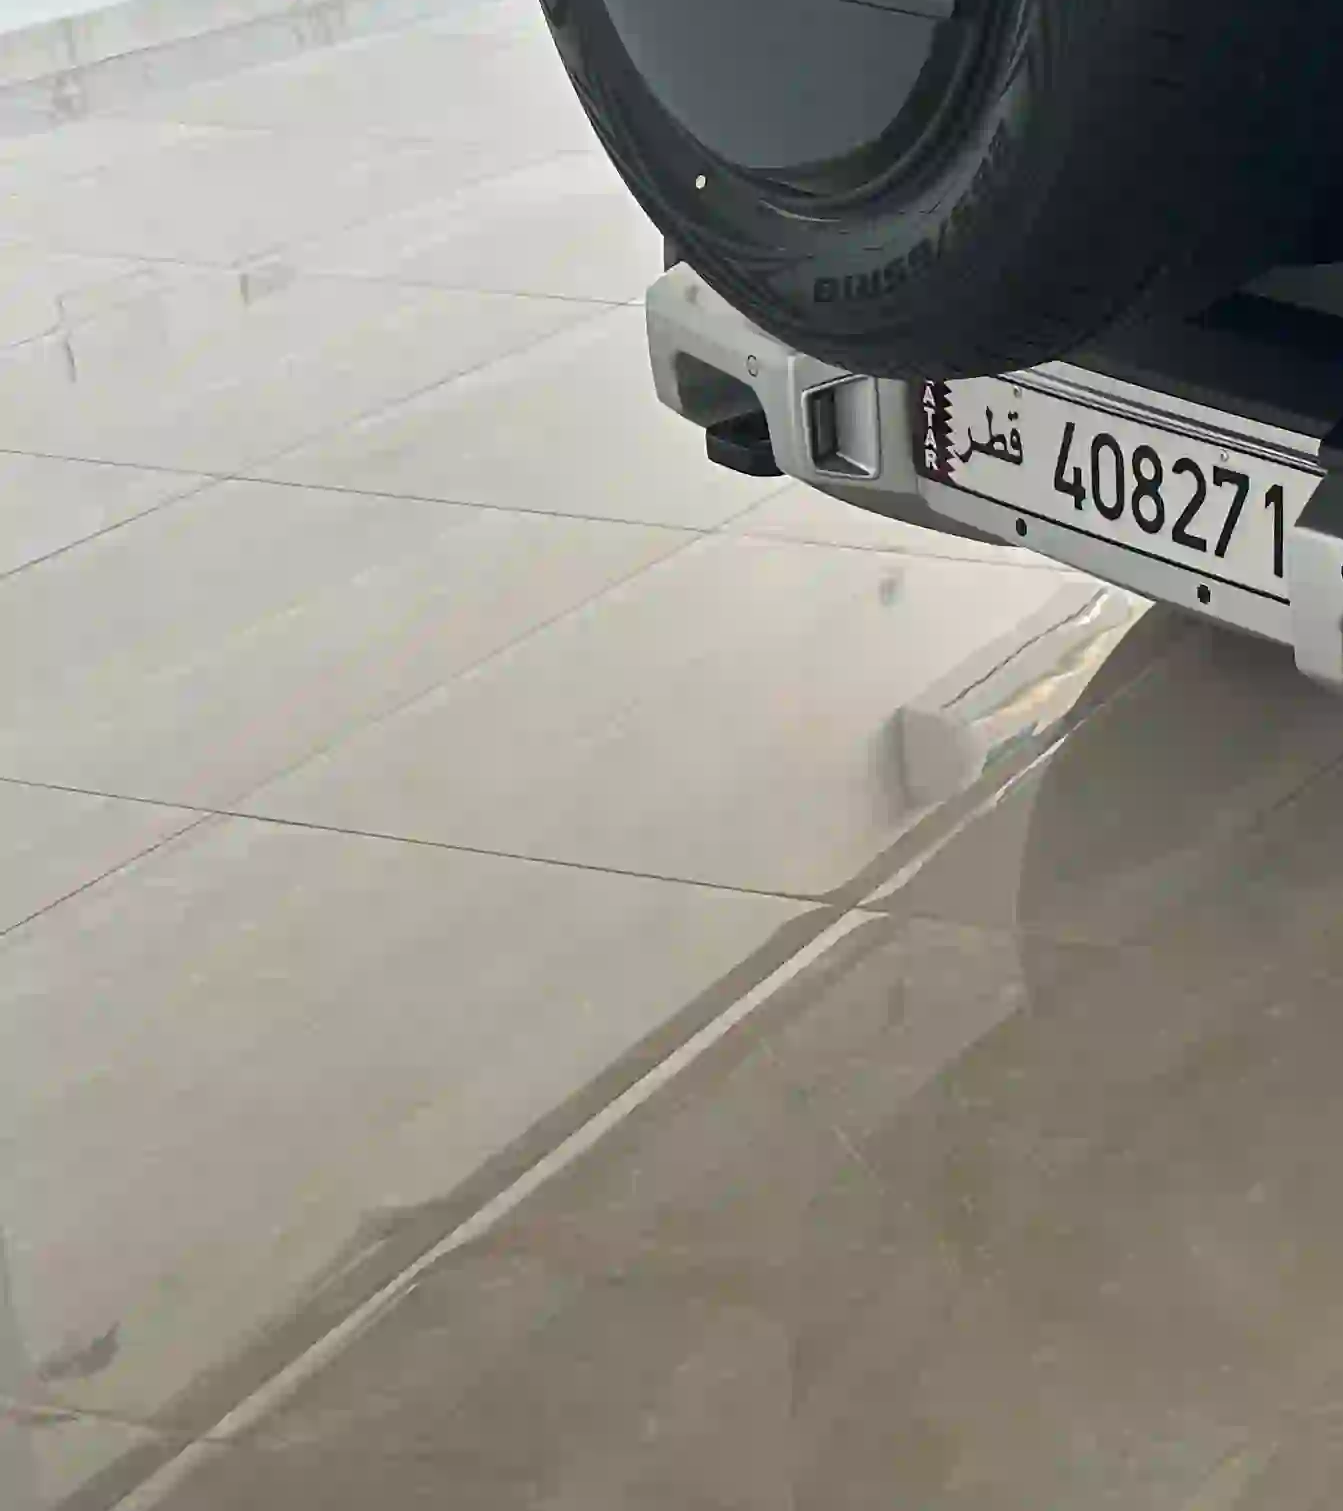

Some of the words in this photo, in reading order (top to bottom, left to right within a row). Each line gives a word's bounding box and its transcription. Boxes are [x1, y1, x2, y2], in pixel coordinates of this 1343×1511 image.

[923, 379, 939, 471] ATAR
[953, 405, 1023, 466] قطر
[1054, 422, 1284, 578] 408271
